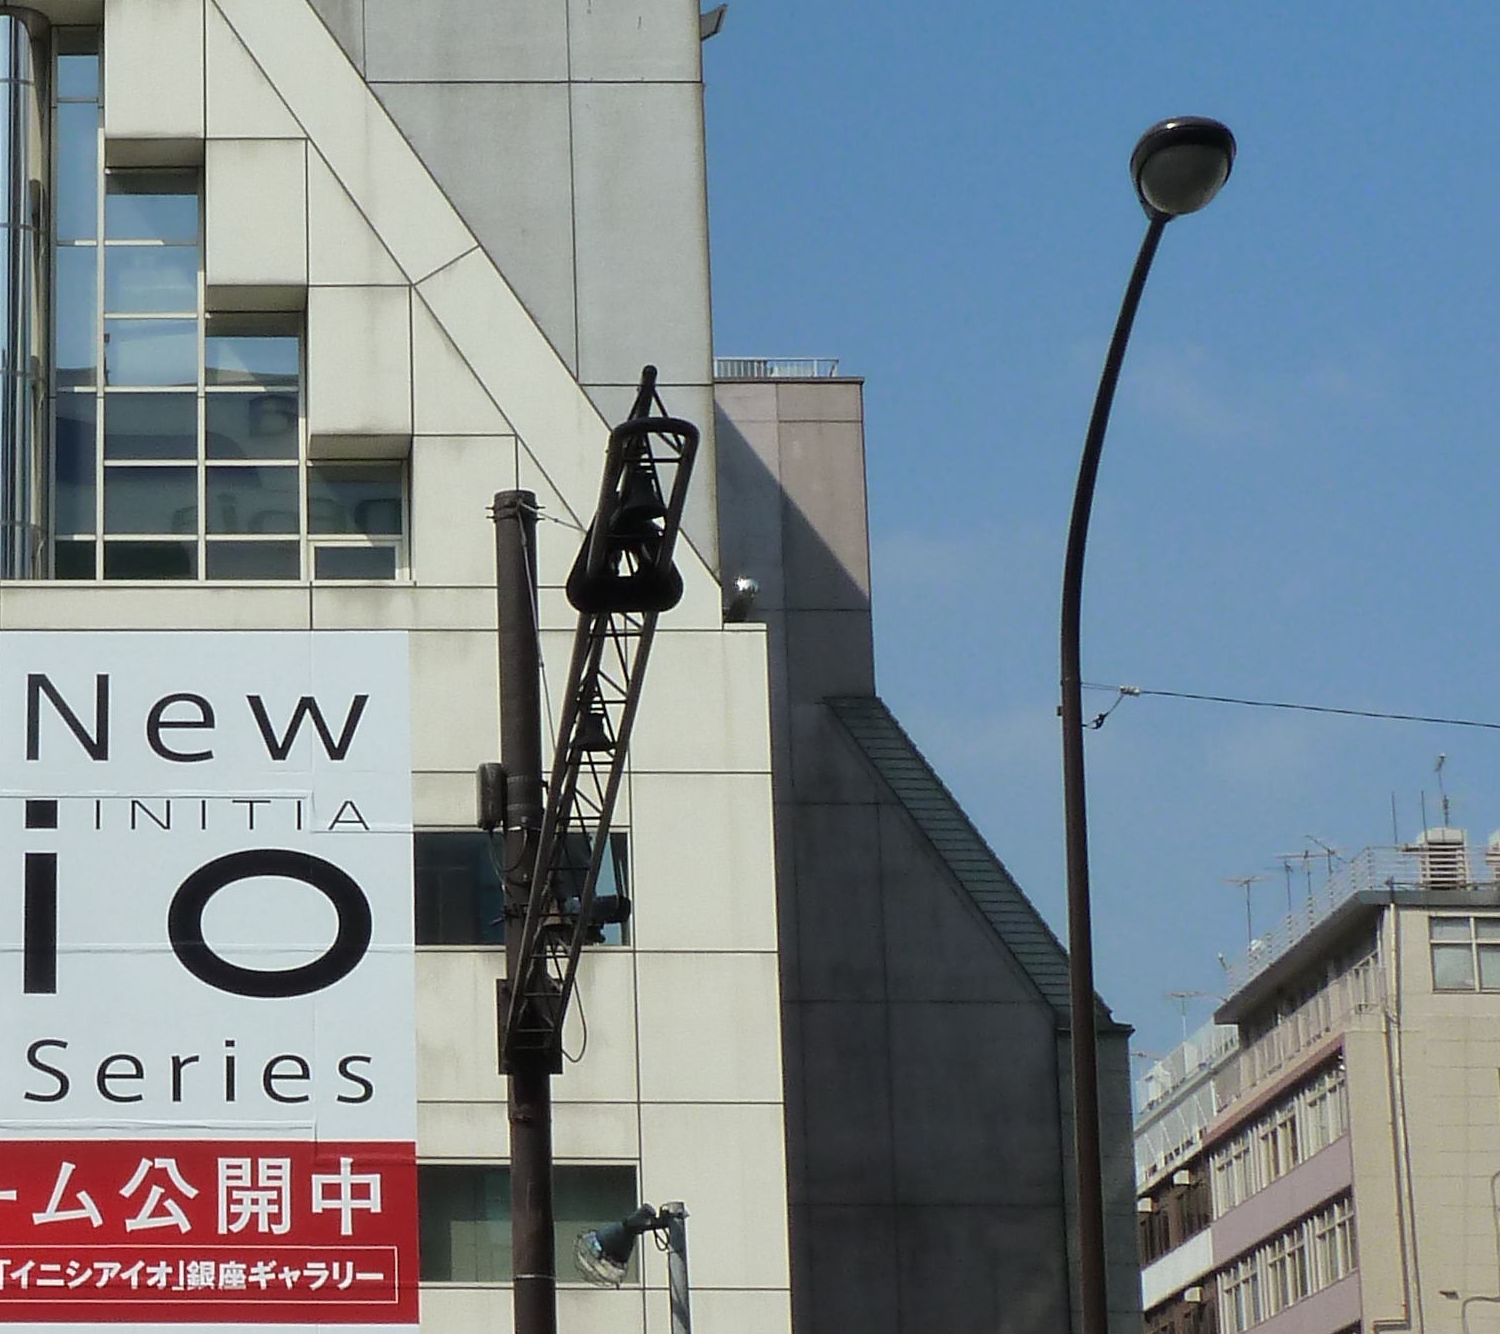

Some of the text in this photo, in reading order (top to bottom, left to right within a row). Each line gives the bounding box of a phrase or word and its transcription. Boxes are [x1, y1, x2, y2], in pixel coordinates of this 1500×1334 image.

[25, 673, 371, 764] New
[95, 799, 372, 832] INITIA
[23, 799, 373, 1000] io
[23, 1037, 375, 1105] Series
